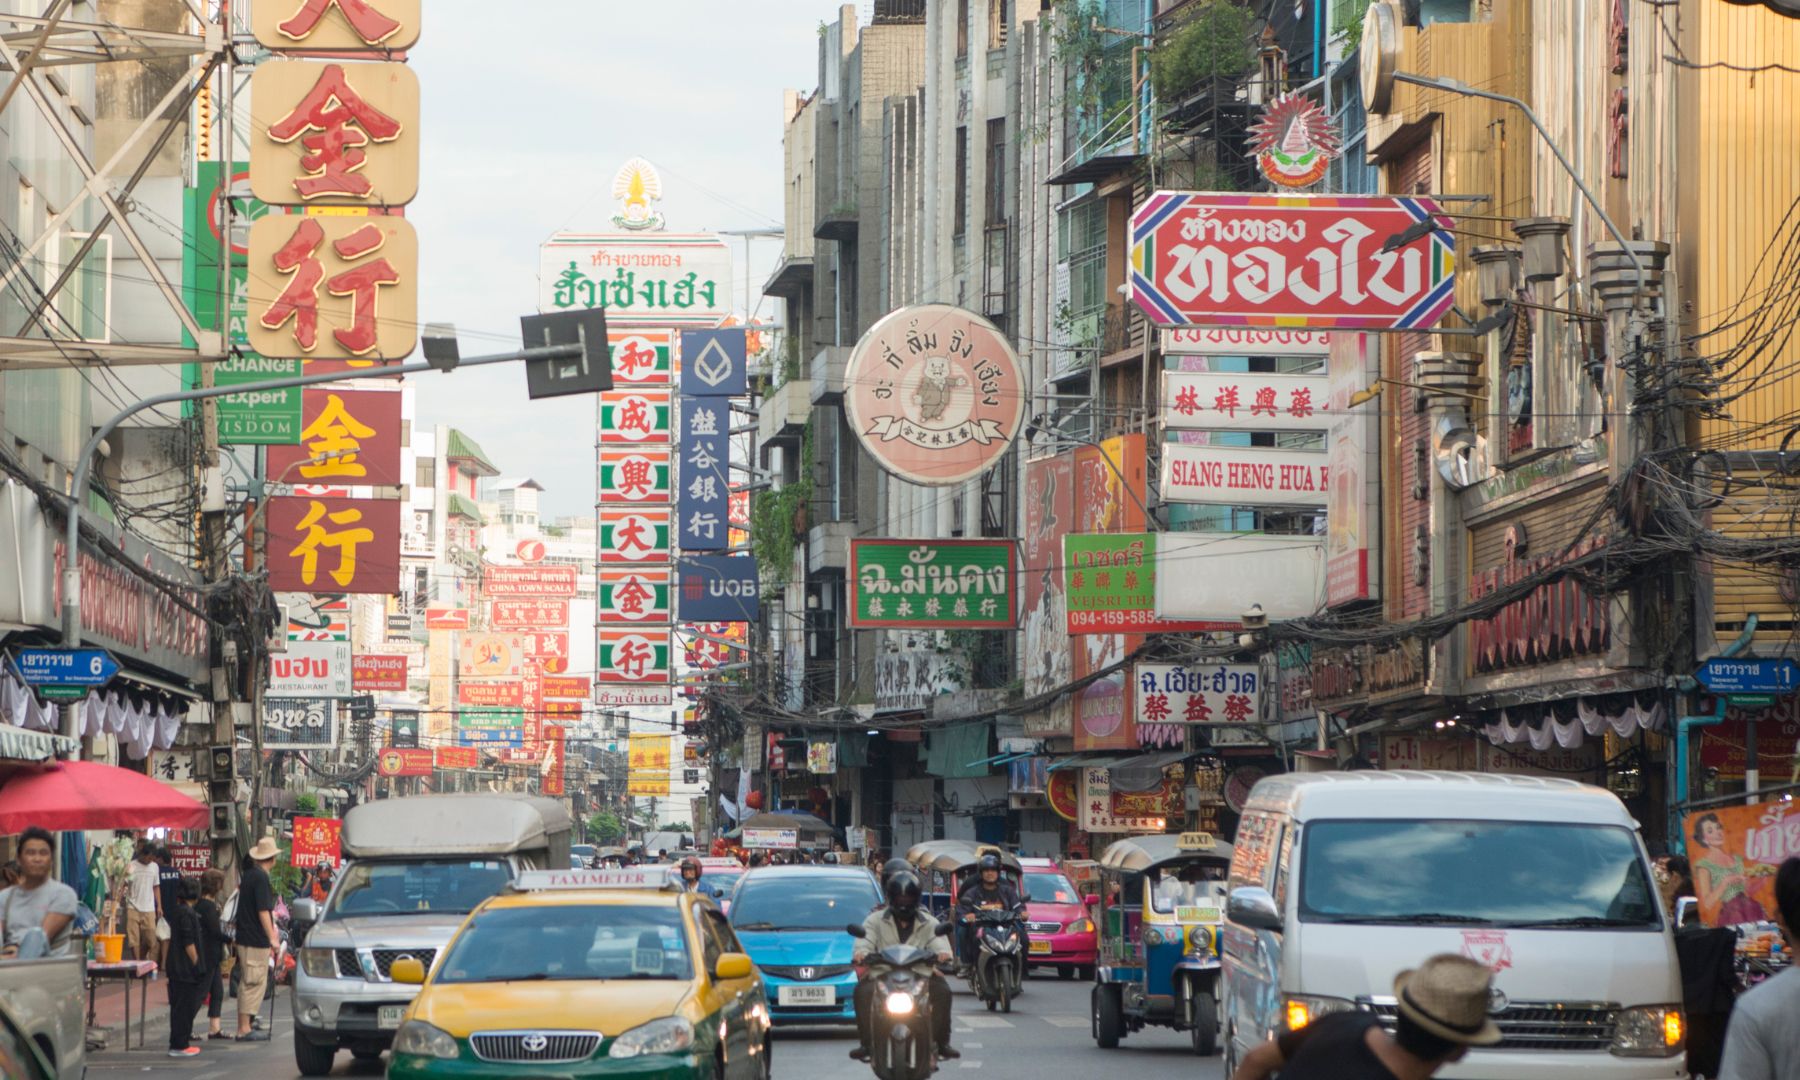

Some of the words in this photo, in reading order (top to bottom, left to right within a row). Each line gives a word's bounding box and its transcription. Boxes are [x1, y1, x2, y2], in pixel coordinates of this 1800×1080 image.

[1180, 208, 1306, 243] ห้างทอง
[1163, 217, 1423, 306] ทองใบ
[212, 357, 296, 373] XCHANGE
[1172, 384, 1329, 419] 林祥興藥
[219, 421, 292, 433] ISDOM
[1171, 459, 1224, 487] SIANG
[1227, 463, 1275, 490] HENG
[1279, 464, 1316, 492] HUA
[1072, 540, 1146, 568] เวชศรี
[489, 585, 515, 593] CHINA
[518, 585, 543, 593] TOWN
[544, 585, 572, 593] SCALA
[709, 579, 757, 598] UOB
[22, 654, 74, 667] เยาวราช
[89, 656, 103, 675] 6
[1708, 663, 1760, 676] เยาวราช
[1183, 834, 1209, 845] TAXI
